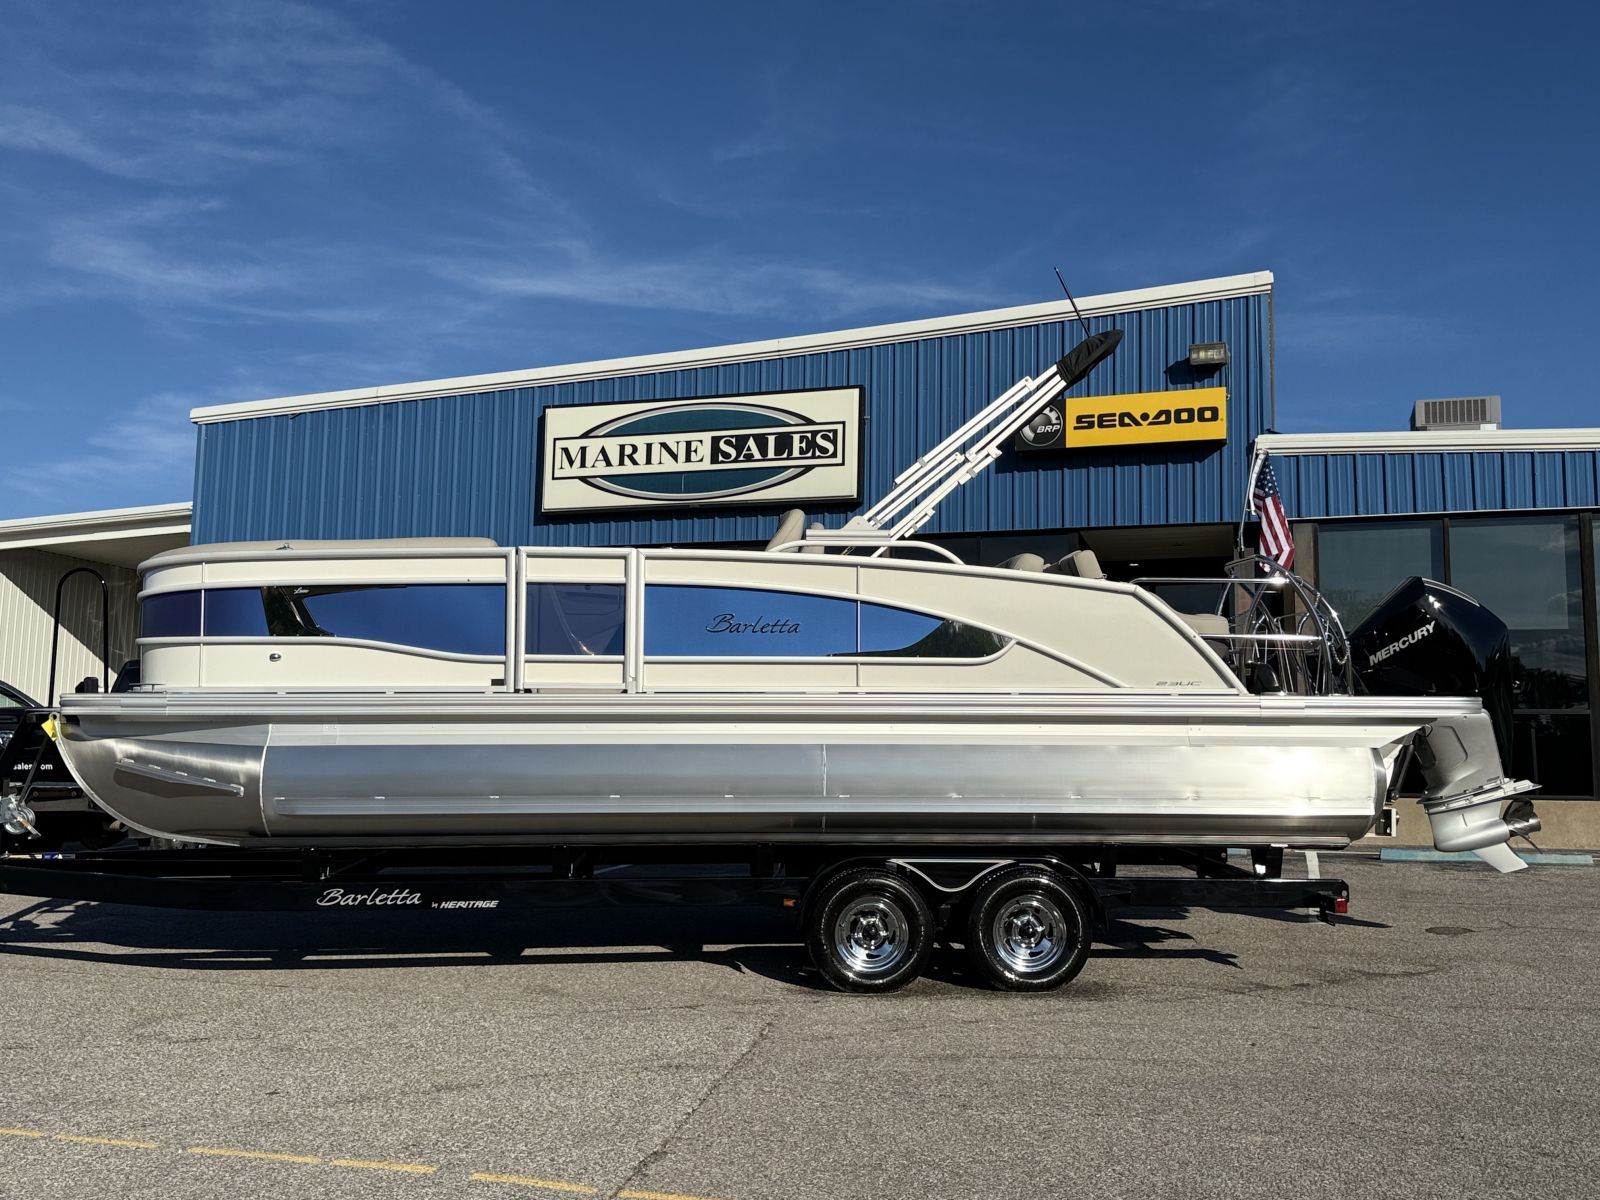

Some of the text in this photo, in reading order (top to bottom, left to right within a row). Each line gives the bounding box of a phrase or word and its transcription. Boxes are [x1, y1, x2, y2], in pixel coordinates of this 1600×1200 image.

[1036, 424, 1061, 434] BRP
[558, 430, 835, 470] MARINE SALES
[705, 613, 800, 633] Barletta
[1369, 620, 1436, 666] MERCURY
[316, 888, 422, 906] Barletta
[439, 900, 500, 909] HERITAGE
